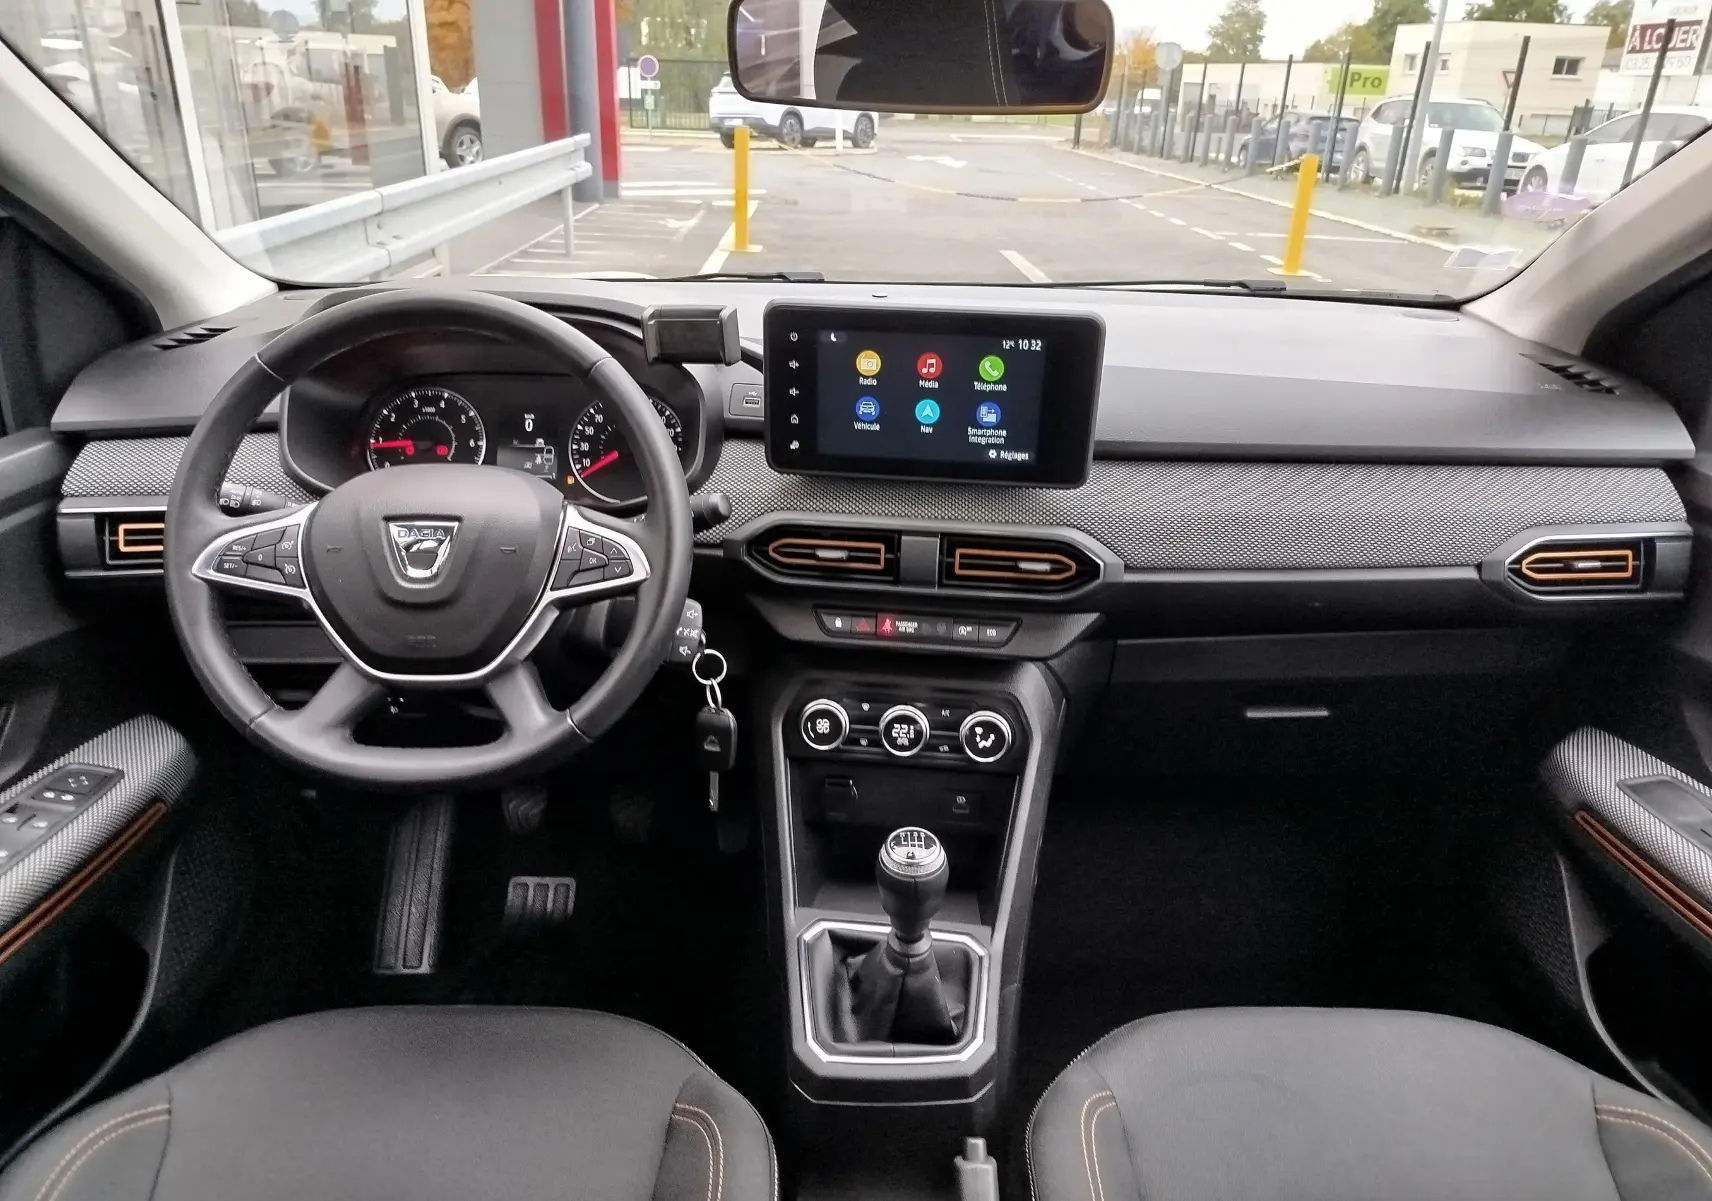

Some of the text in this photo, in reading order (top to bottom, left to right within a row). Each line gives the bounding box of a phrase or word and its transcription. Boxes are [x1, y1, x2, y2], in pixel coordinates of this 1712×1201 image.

[1349, 72, 1383, 88] Pro
[859, 376, 877, 386] Radio
[919, 379, 939, 389] Média
[974, 381, 1007, 392] Téléphone
[413, 399, 419, 409] 3
[439, 400, 445, 409] 4
[390, 413, 396, 422] 2
[595, 414, 603, 423] 70
[525, 419, 533, 432] 0
[585, 426, 594, 435] 50
[853, 421, 881, 431] Véhicule
[920, 424, 933, 433] Nav
[967, 426, 1007, 437] Smartphone
[469, 438, 475, 447] 6
[968, 435, 1005, 445] Integration
[580, 442, 589, 451] 30
[1000, 450, 1029, 461] Réglages
[582, 458, 591, 467] 10
[397, 528, 446, 540] DACIA
[589, 557, 597, 565] OK
[987, 628, 996, 637] ECO
